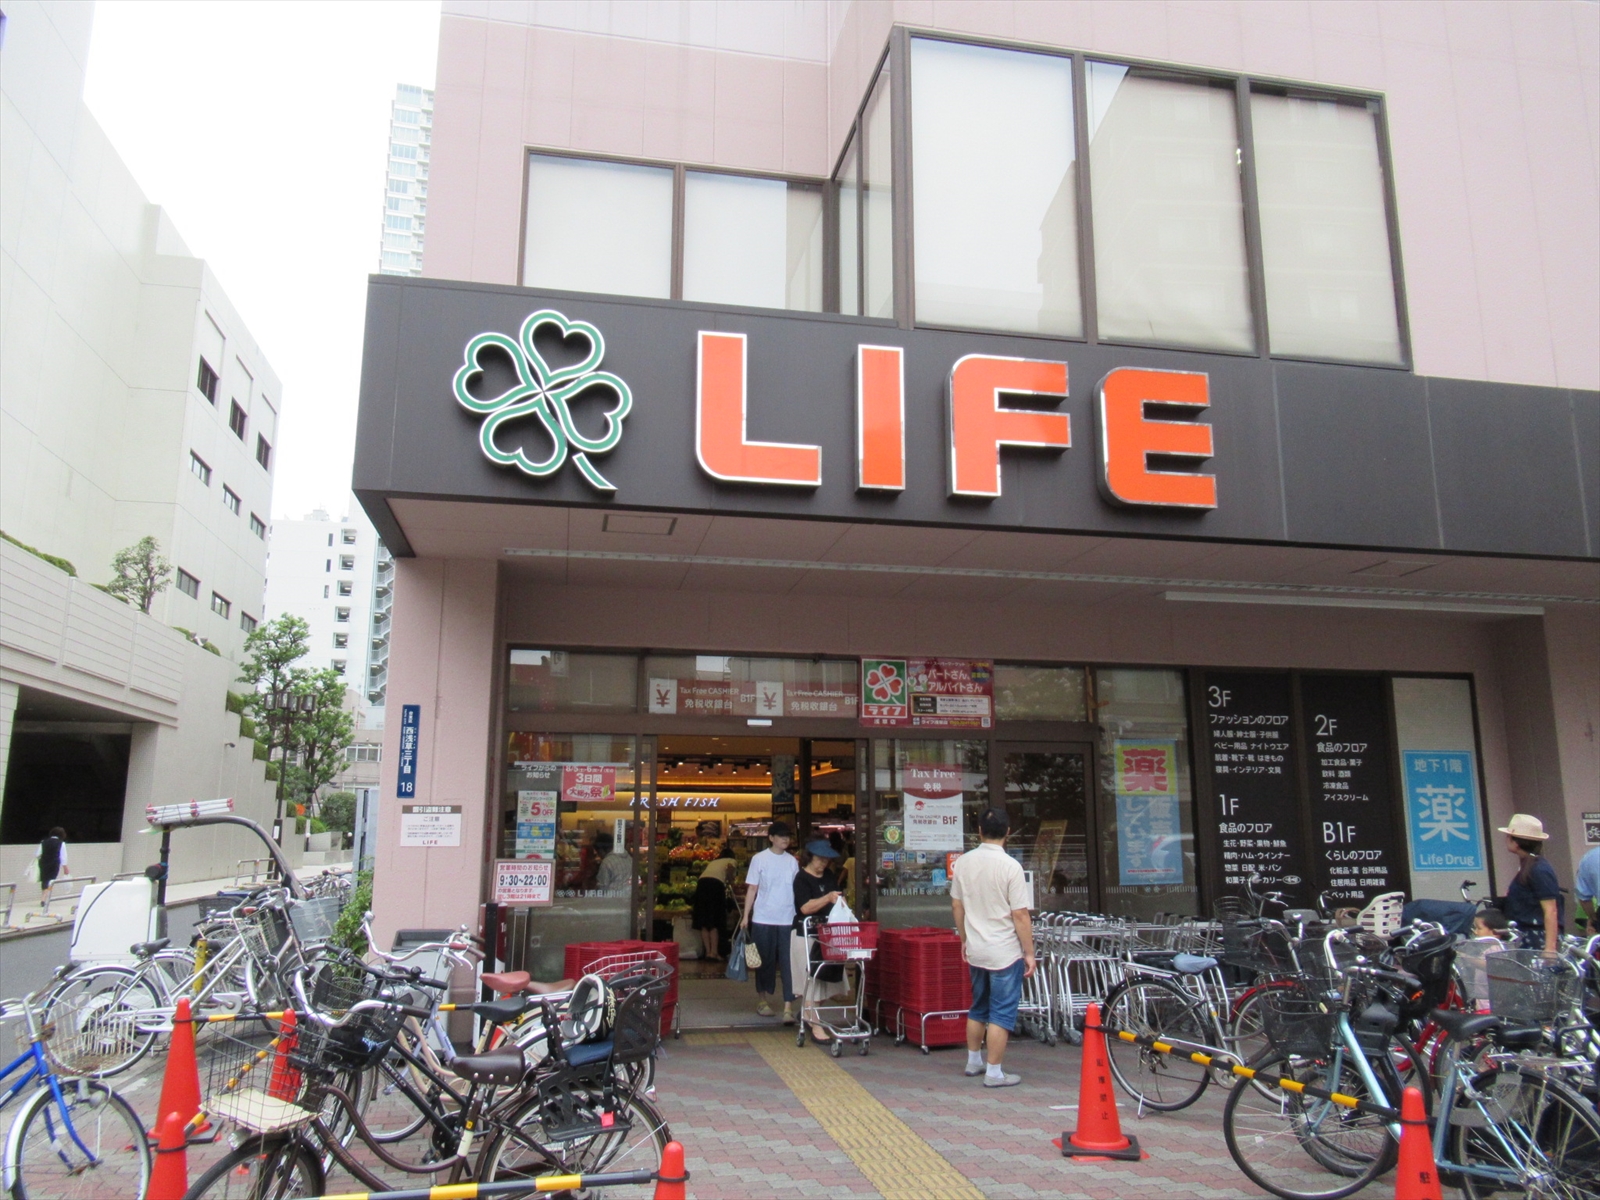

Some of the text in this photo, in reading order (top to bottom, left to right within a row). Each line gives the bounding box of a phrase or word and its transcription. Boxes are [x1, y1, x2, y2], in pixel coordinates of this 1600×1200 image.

[695, 330, 1218, 509] LIFE
[928, 682, 982, 692] アルバイトさん
[1208, 685, 1231, 707] 3F
[868, 706, 902, 716] ライフ
[1210, 714, 1288, 725] ファッションのフロア
[1315, 714, 1338, 736] 2F
[403, 726, 414, 774] 西浅草三丁目
[1316, 742, 1368, 752] 食品のフロア
[1122, 748, 1168, 792] 薬
[1215, 766, 1281, 774] 寝具・インテリア・文具
[1414, 758, 1462, 773] 地下1階
[576, 773, 602, 783] 3日間
[910, 769, 955, 778] Tax Free
[401, 782, 413, 792] 18
[923, 782, 942, 792] 免税
[684, 796, 720, 807] FISH
[1219, 794, 1239, 816] 1F
[530, 802, 541, 816] 5
[1416, 784, 1470, 842] 薬
[943, 816, 958, 825] B1F
[1219, 822, 1272, 834] 食品のフロア
[1323, 822, 1356, 843] B1F
[1325, 850, 1382, 860] くらしのフロア
[1420, 854, 1474, 866] Life Drug
[500, 875, 547, 886] 9:30~22:00
[1332, 890, 1364, 898] ペット用品
